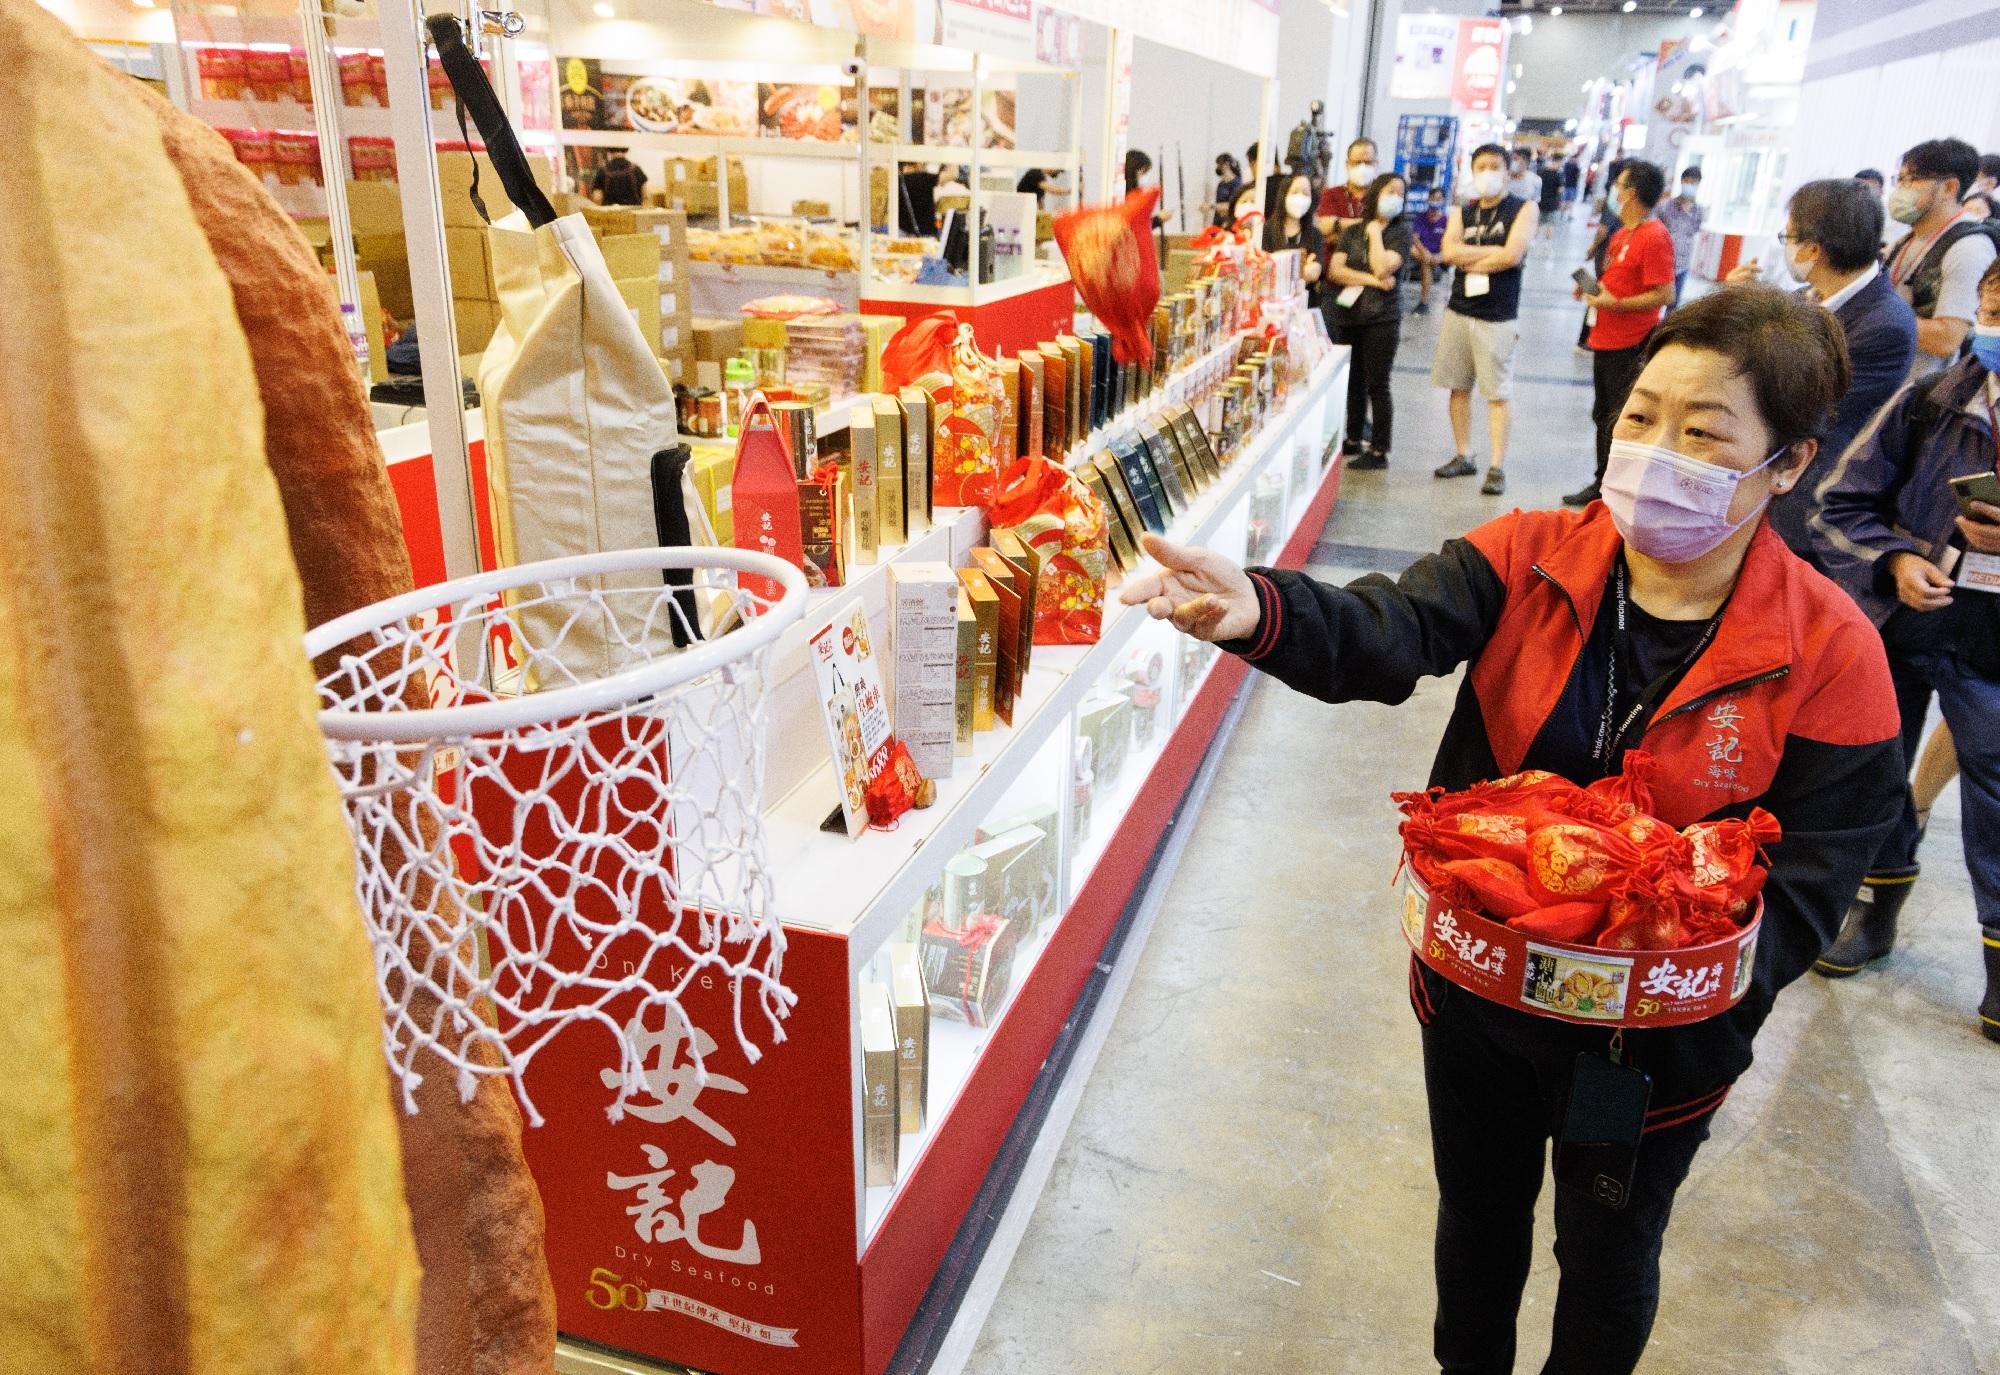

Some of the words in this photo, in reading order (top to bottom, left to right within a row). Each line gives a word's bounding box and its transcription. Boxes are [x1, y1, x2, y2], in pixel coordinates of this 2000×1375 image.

[857, 460, 872, 486] 安記
[882, 444, 897, 468] 安記
[978, 631, 992, 654] 安記
[1619, 703, 1643, 733] Sourcing
[1706, 700, 1745, 764] 安記
[1433, 909, 1490, 971] 安記
[1640, 958, 1709, 999] 安記
[600, 999, 762, 1265] 安記
[615, 1246, 653, 1267] Dry
[671, 1259, 774, 1295] Seafood
